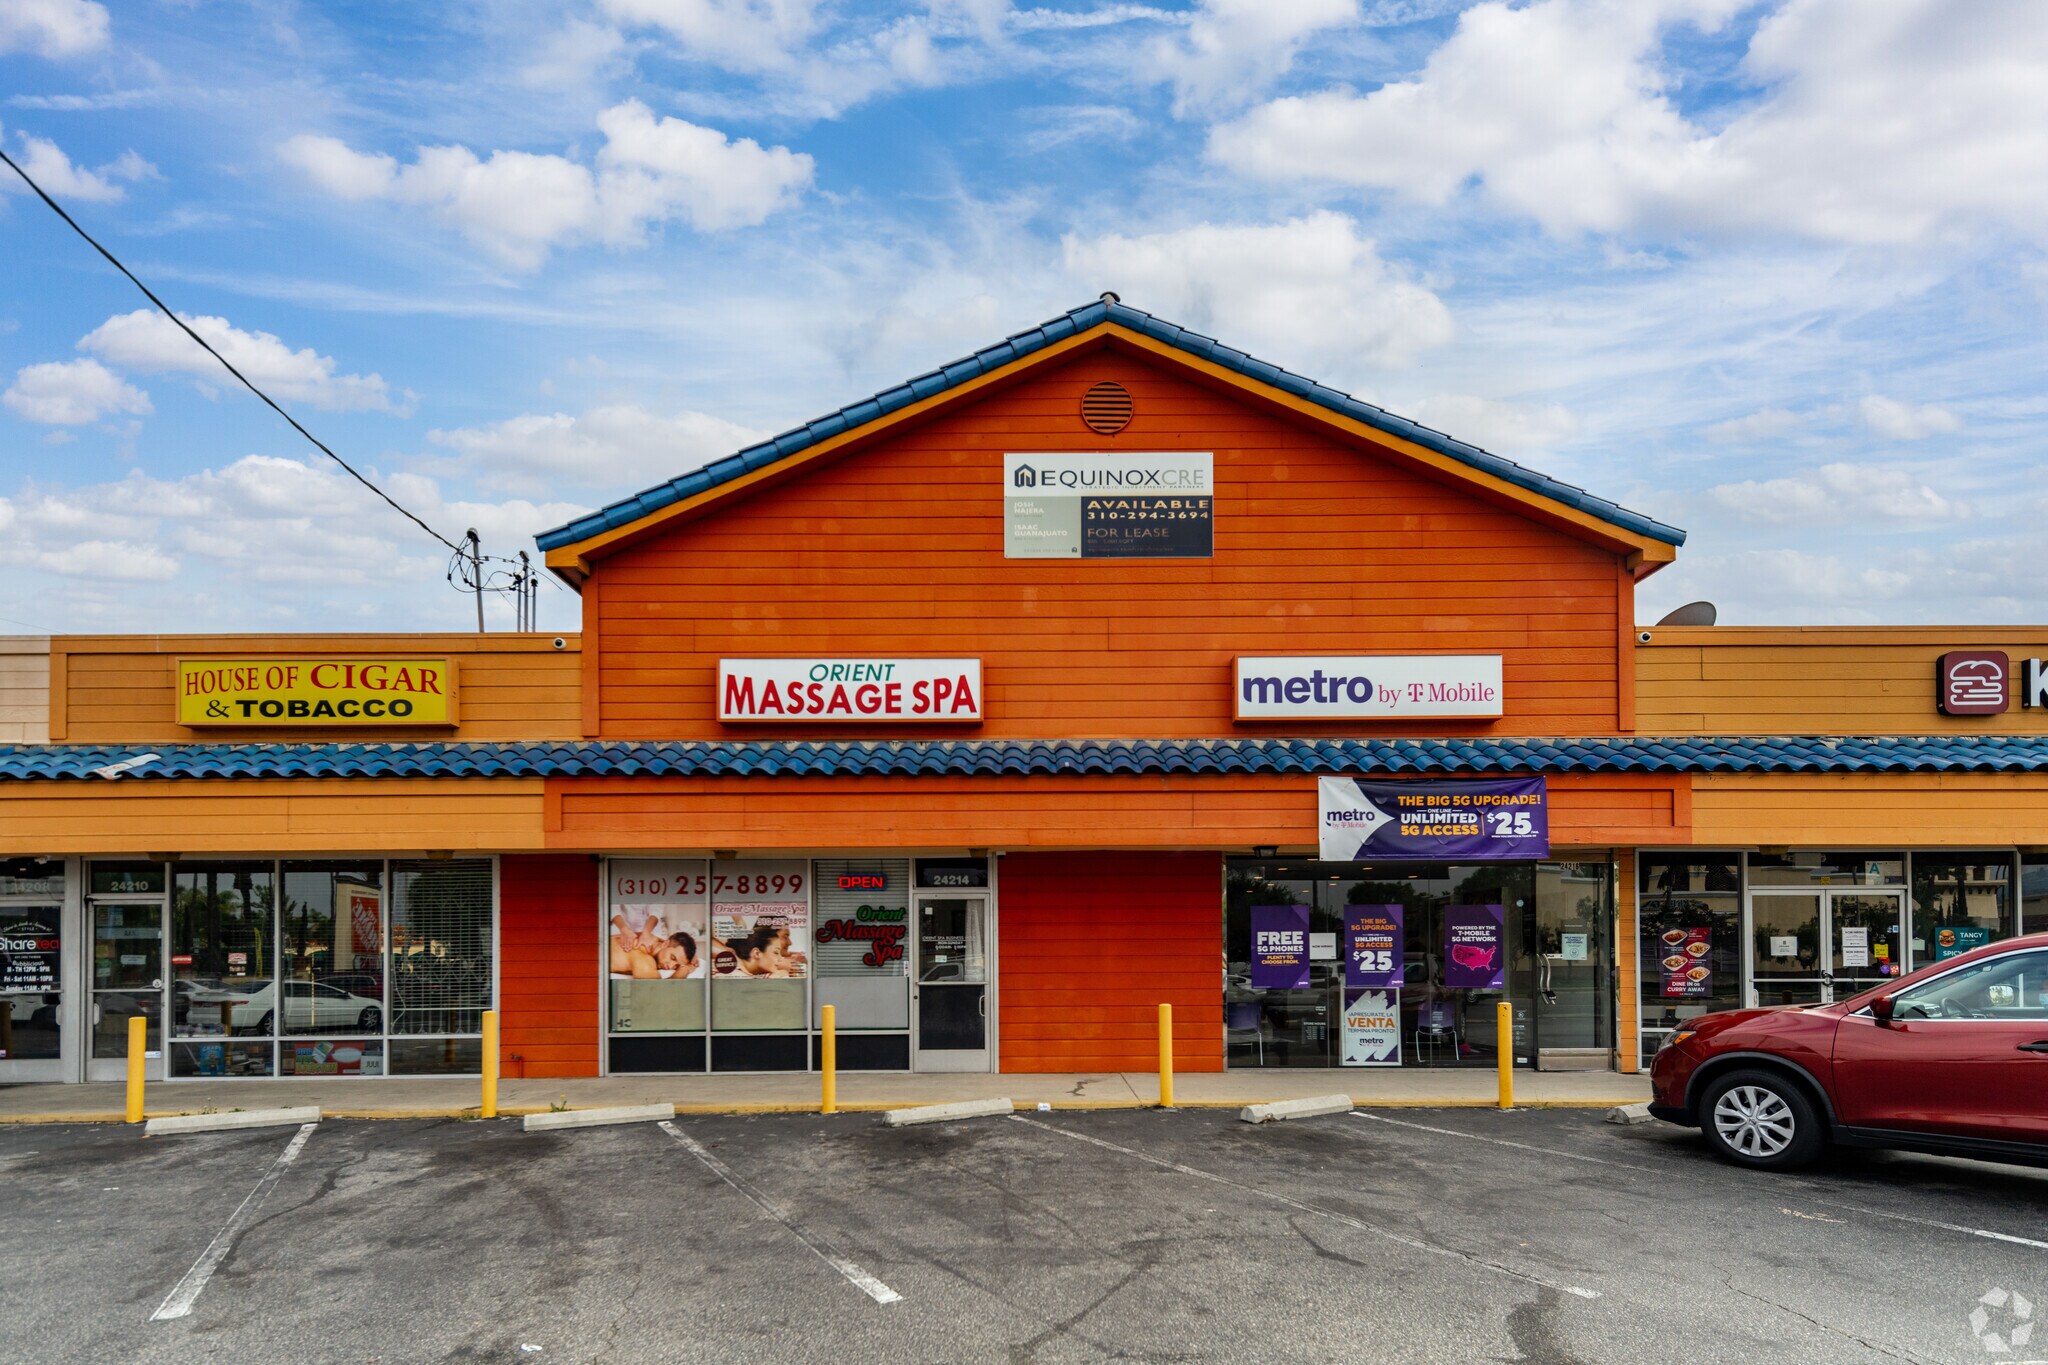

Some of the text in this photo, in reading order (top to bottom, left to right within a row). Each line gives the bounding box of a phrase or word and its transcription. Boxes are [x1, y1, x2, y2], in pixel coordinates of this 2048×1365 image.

[1088, 500, 1209, 509] AVAILABLE
[1088, 528, 1170, 538] FOR LEASE
[186, 664, 442, 696] HOUSE OF CIGAR
[809, 664, 896, 682] ORIENT
[724, 674, 978, 715] MASSAGE SPA
[1242, 670, 1374, 704] metro
[1378, 684, 1402, 708] by
[206, 699, 414, 718] & TOBACCO
[1398, 794, 1541, 806] THE BIG 5G UPGRADE!
[1326, 808, 1376, 822] metro
[1400, 813, 1478, 824] UNLIMITED
[1486, 812, 1532, 835] $25
[1401, 824, 1479, 836] 5G ACCESS
[1869, 862, 1880, 874] A
[110, 880, 149, 892] 24210
[617, 874, 803, 896] (310) 257-8899
[838, 876, 884, 888] OPEN
[934, 875, 970, 886] 24214
[714, 903, 806, 916] Orient Massage Spa
[856, 905, 906, 922] Orient
[816, 920, 906, 946] Massage
[1257, 931, 1304, 945] FREE
[0, 937, 60, 950] Sharetea
[863, 940, 904, 967] Spa
[1353, 950, 1393, 971] $25
[1347, 1018, 1395, 1028] VENTA
